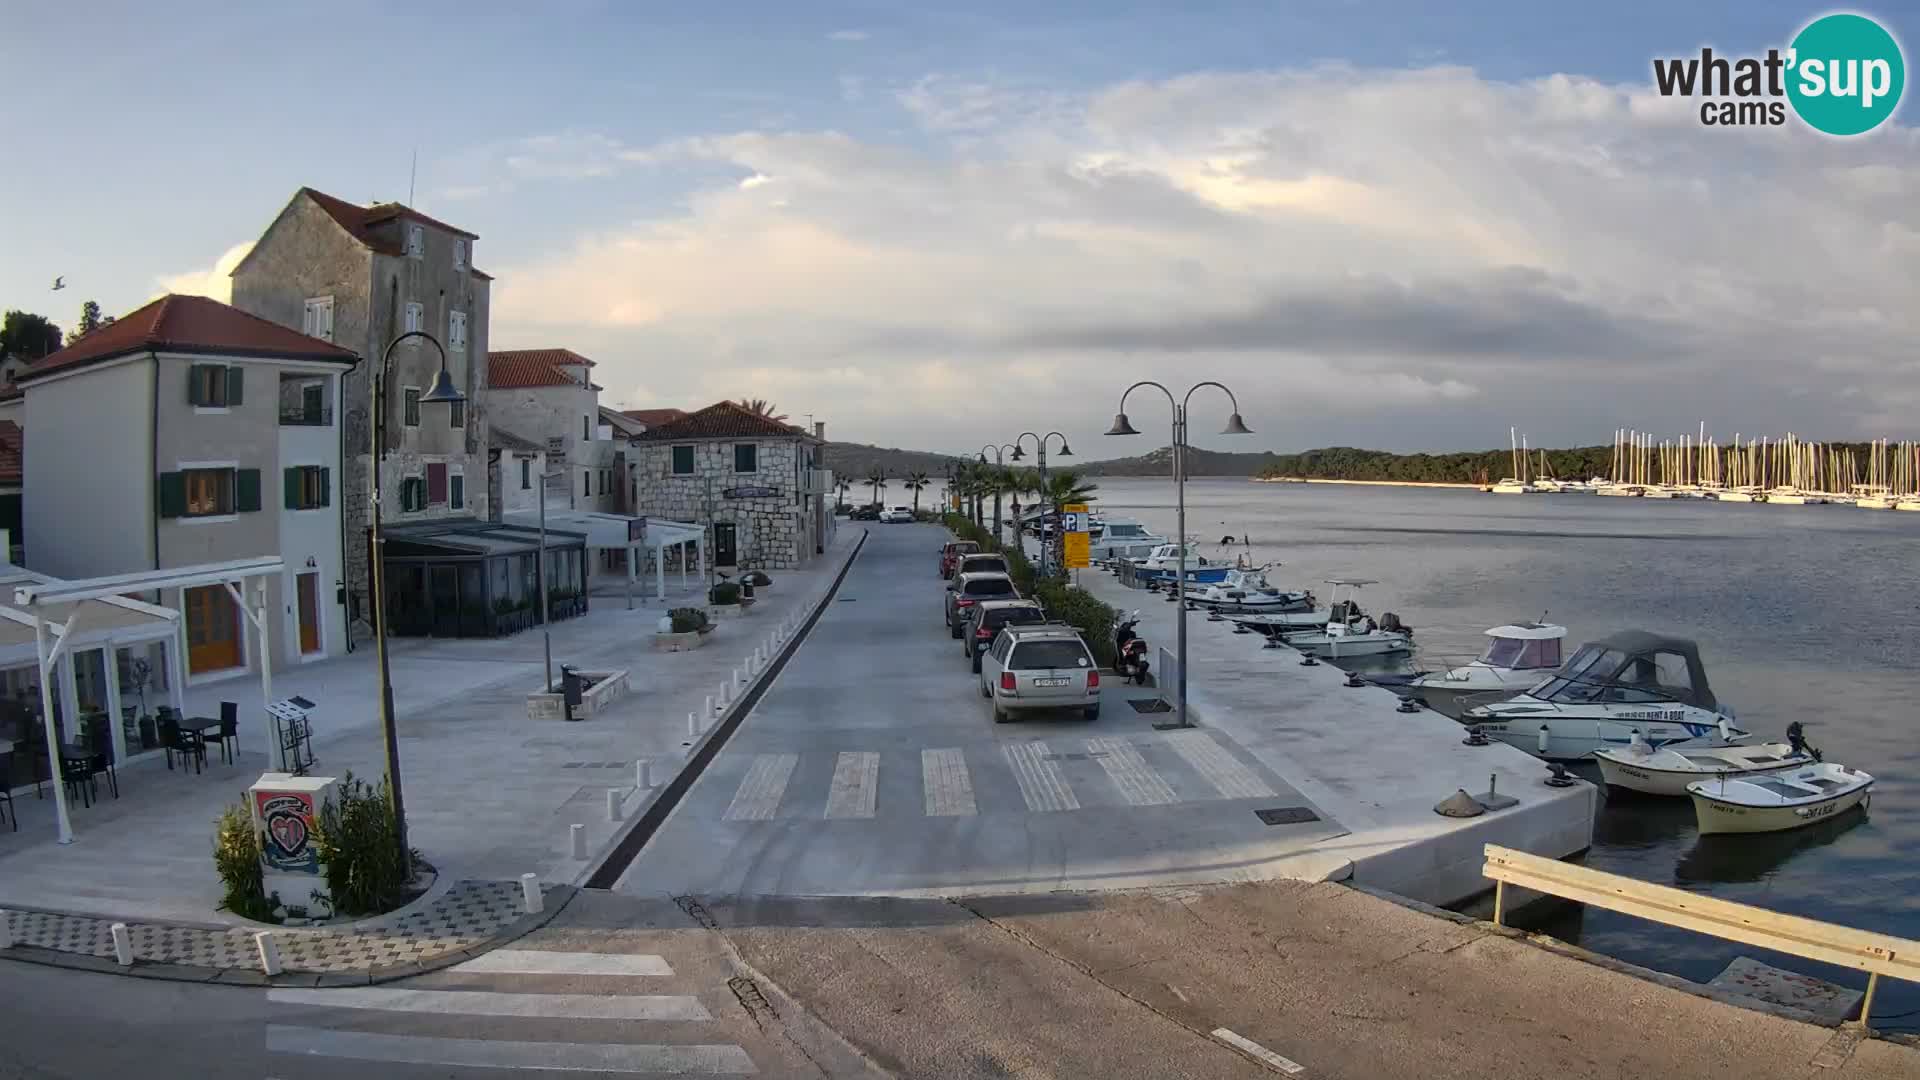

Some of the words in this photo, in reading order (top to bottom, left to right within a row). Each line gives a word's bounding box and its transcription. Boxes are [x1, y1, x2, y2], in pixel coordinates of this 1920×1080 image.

[1066, 514, 1077, 530] P
[1647, 711, 1663, 720] RENT
[1663, 711, 1669, 720] A
[1669, 711, 1685, 721] BOAT
